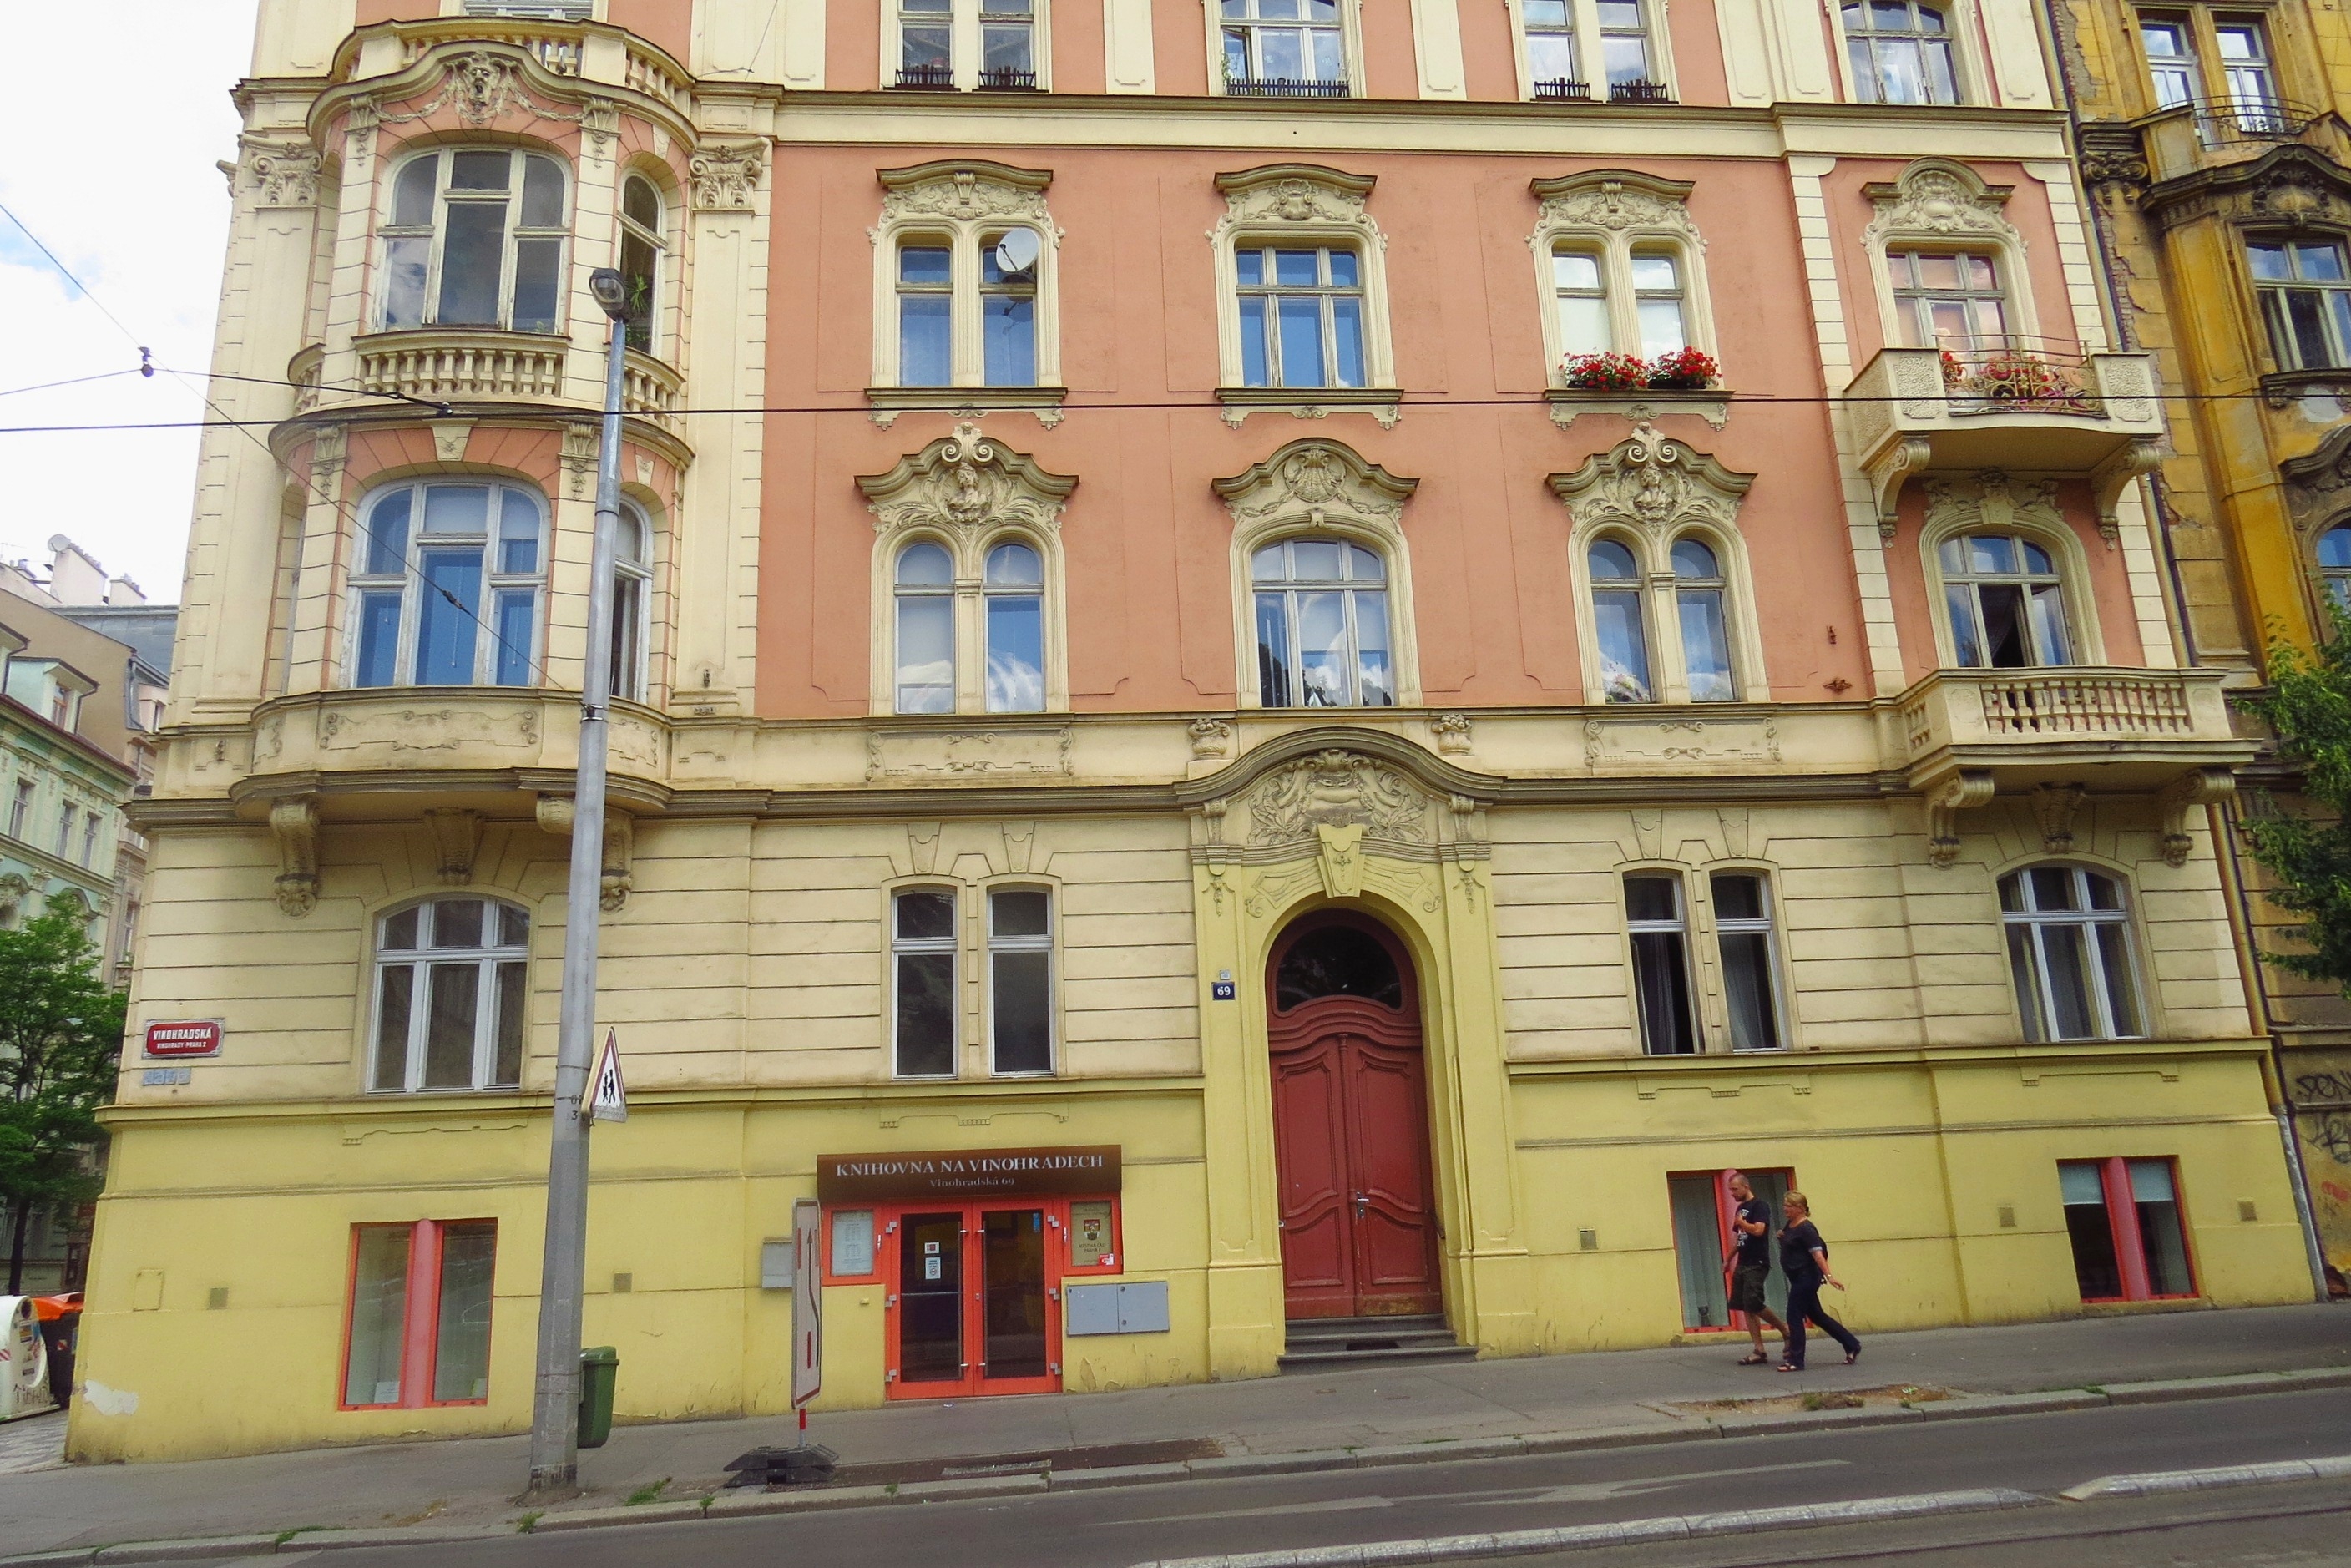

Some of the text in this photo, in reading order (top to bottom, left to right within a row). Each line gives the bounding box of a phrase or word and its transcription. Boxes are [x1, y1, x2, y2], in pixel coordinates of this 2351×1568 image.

[1217, 986, 1231, 996] 69
[154, 1027, 212, 1040] VINOHRADSKÁ
[836, 1155, 1103, 1176] KNIHOVNA NA VINOHRADECH
[929, 1176, 1014, 1187] Vinohradská 69
